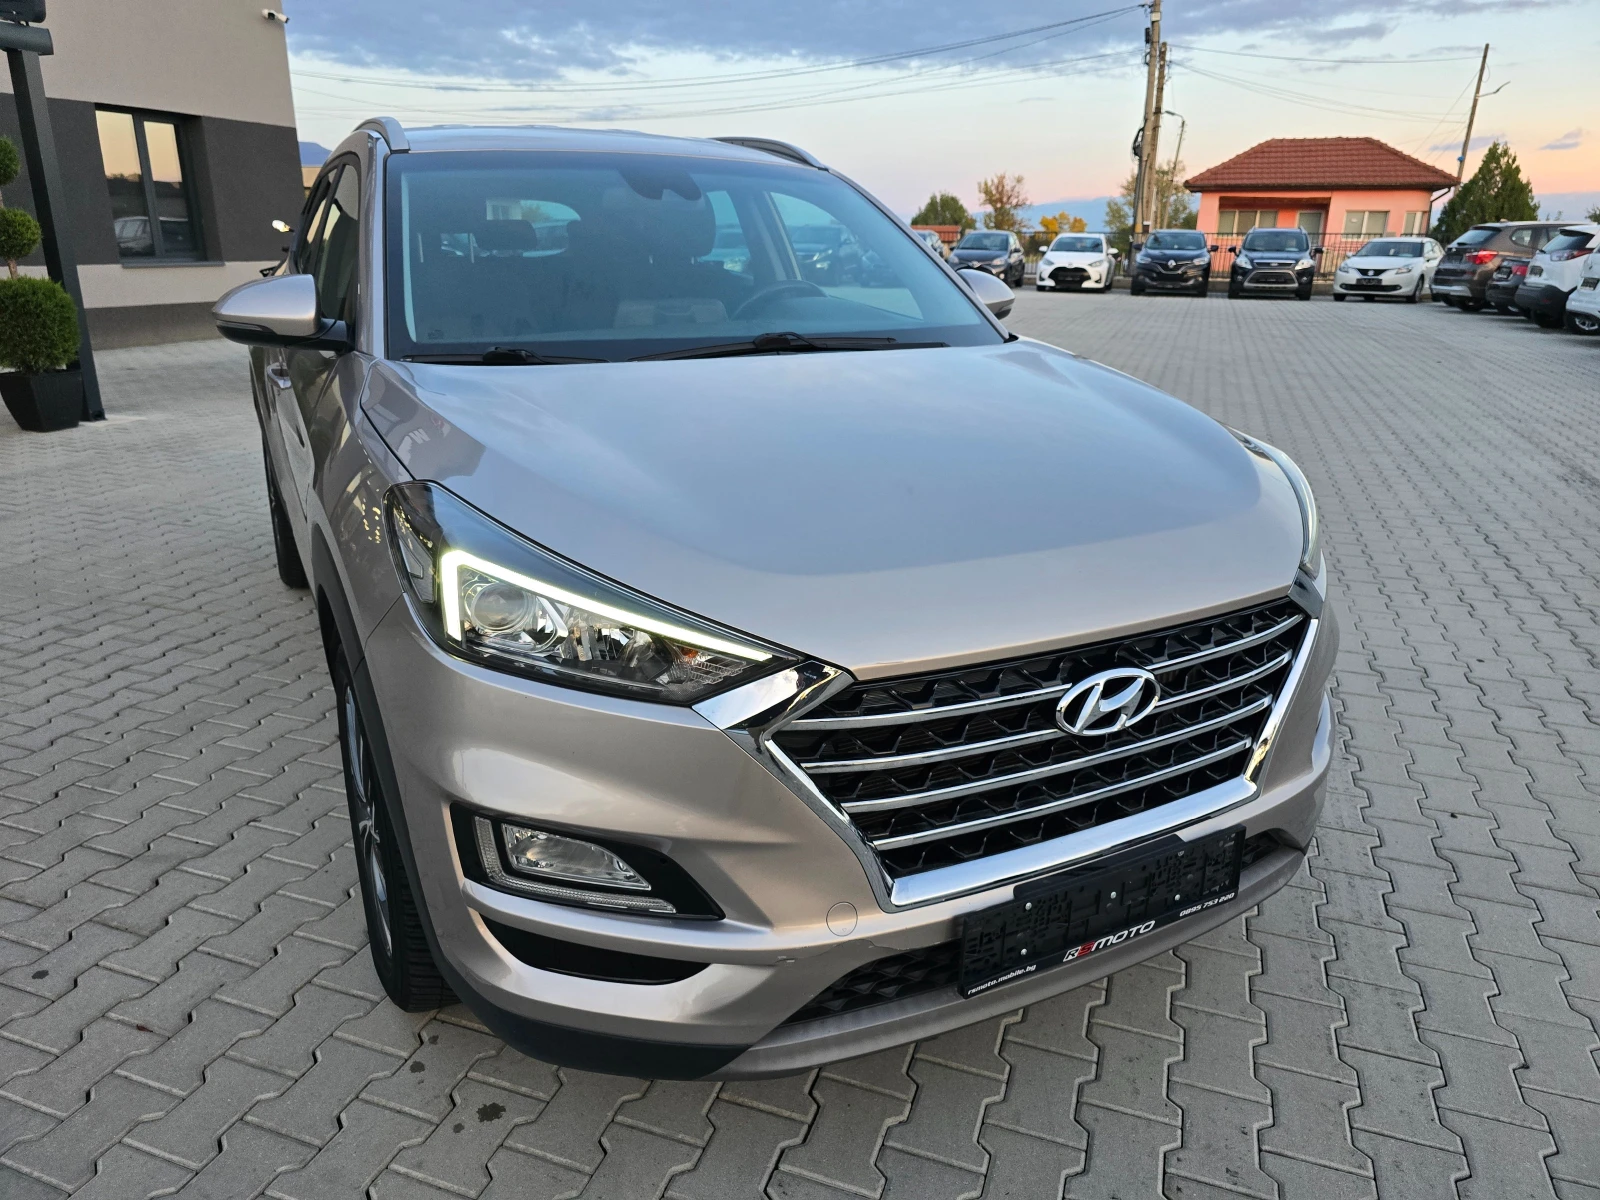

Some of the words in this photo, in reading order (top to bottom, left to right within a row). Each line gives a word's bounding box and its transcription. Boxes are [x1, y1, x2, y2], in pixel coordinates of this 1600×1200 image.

[1179, 904, 1202, 917] 0895
[1203, 898, 1219, 908] 753
[1063, 921, 1156, 962] RSMOTO
[967, 964, 1037, 996] rsmoto.mobile.bg
